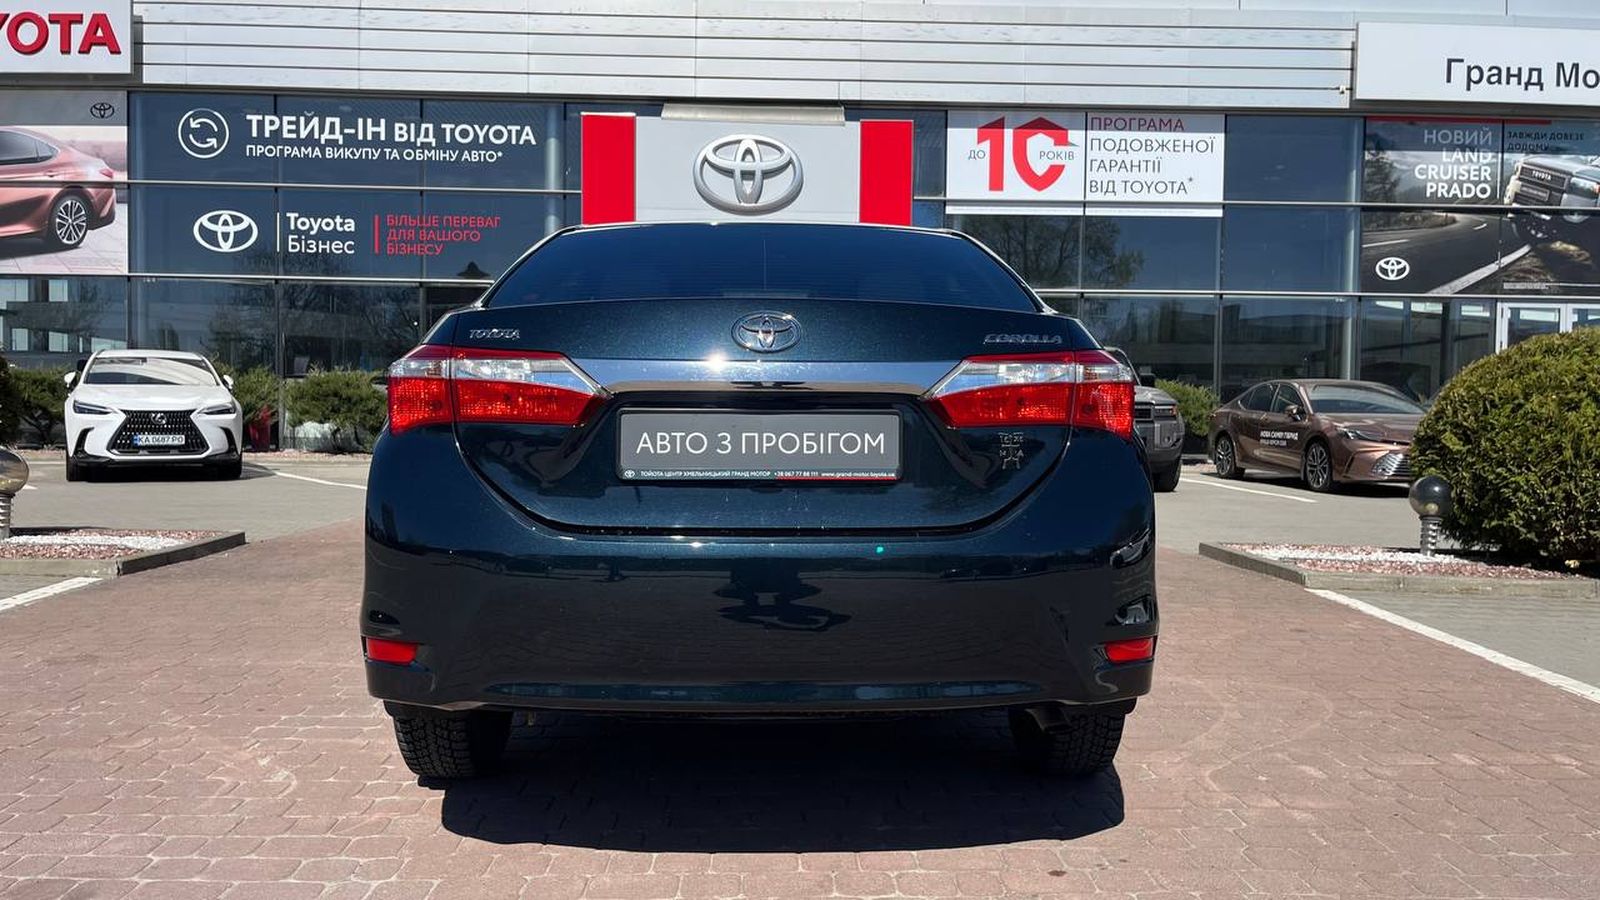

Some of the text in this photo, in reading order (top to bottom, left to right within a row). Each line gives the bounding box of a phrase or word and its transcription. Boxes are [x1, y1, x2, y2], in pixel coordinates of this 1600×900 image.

[0, 12, 122, 56] OTA
[1445, 58, 1544, 91] Гранд
[246, 111, 536, 147] ТРЕЙД-ІН ВІД TOYOTA
[1090, 116, 1184, 132] ПРОГРАМА
[1090, 136, 1216, 153] ПОДОВЖЕНОЇ
[1424, 127, 1492, 145] НОВИЙ
[246, 145, 322, 158] ПРОГРАМА
[325, 147, 380, 160] ВИКУПУ
[384, 148, 400, 161] ТА
[403, 149, 458, 162] ОБМІНУ
[968, 150, 986, 160] ДО
[1039, 151, 1075, 161] РОКІВ
[1442, 148, 1492, 164] LAND
[1089, 157, 1162, 174] ГАРАНТІЇ
[1414, 164, 1492, 181] CRUISER
[1089, 180, 1117, 196] ВІД
[1426, 183, 1492, 199] PRADO
[286, 213, 355, 234] Toyota
[387, 215, 501, 228] БІЛЬШЕ ПЕРЕВАГ
[387, 229, 481, 242] ДЛЯ ВАШОГО
[288, 235, 355, 254] Бізнес
[387, 243, 443, 255] БІЗНЕСУ
[469, 328, 521, 340] TOYOTA
[982, 333, 1062, 345] COROLLA
[636, 432, 708, 454] АВТО
[742, 432, 884, 454] ПРОБІГОМ
